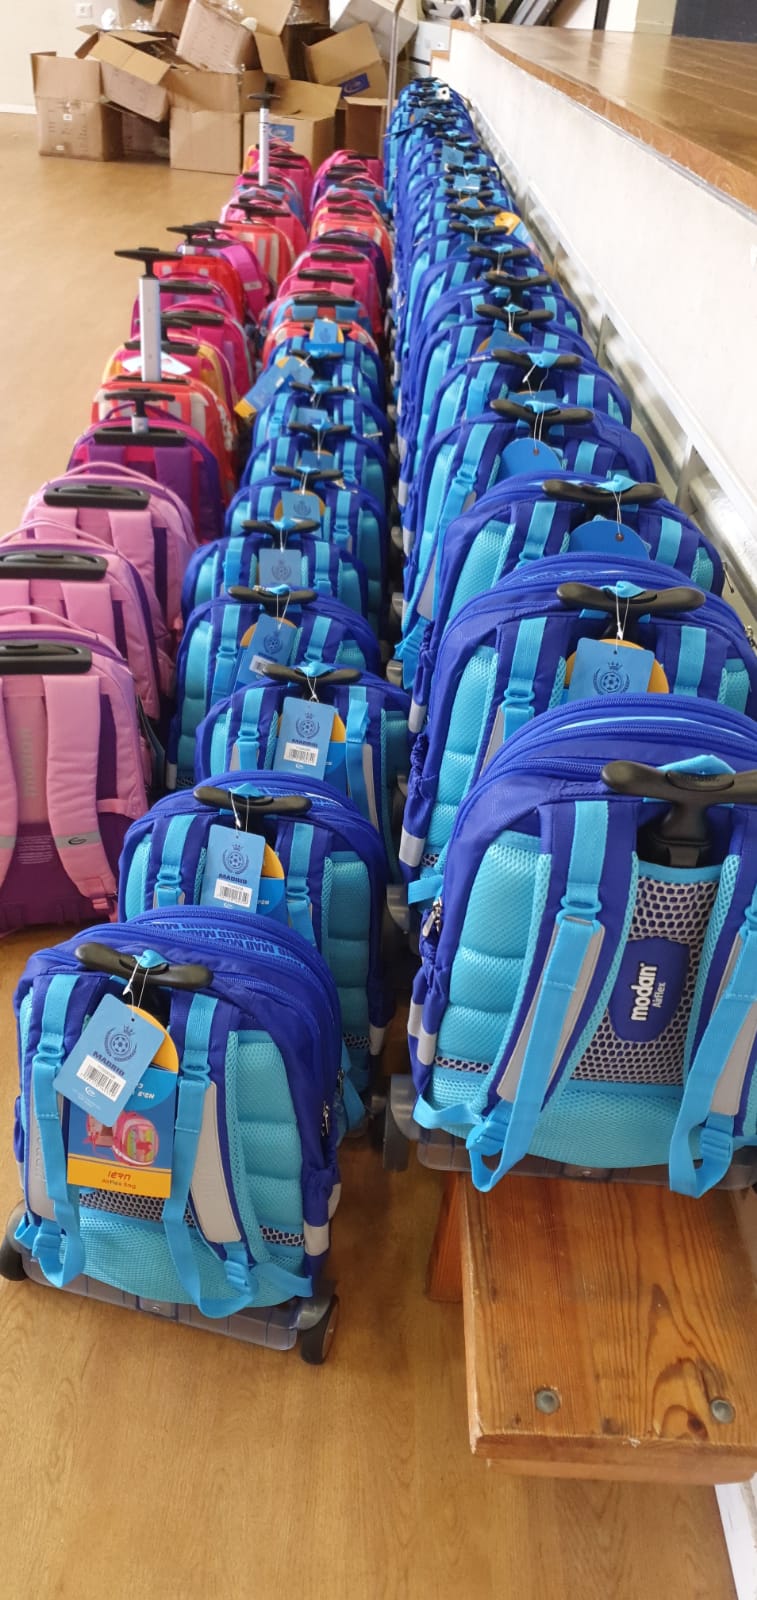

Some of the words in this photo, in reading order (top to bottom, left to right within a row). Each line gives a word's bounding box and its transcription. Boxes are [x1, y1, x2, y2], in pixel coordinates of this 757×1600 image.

[630, 965, 658, 1021] modan
[652, 982, 667, 1008] Airflex
[92, 1051, 125, 1076] MADRID
